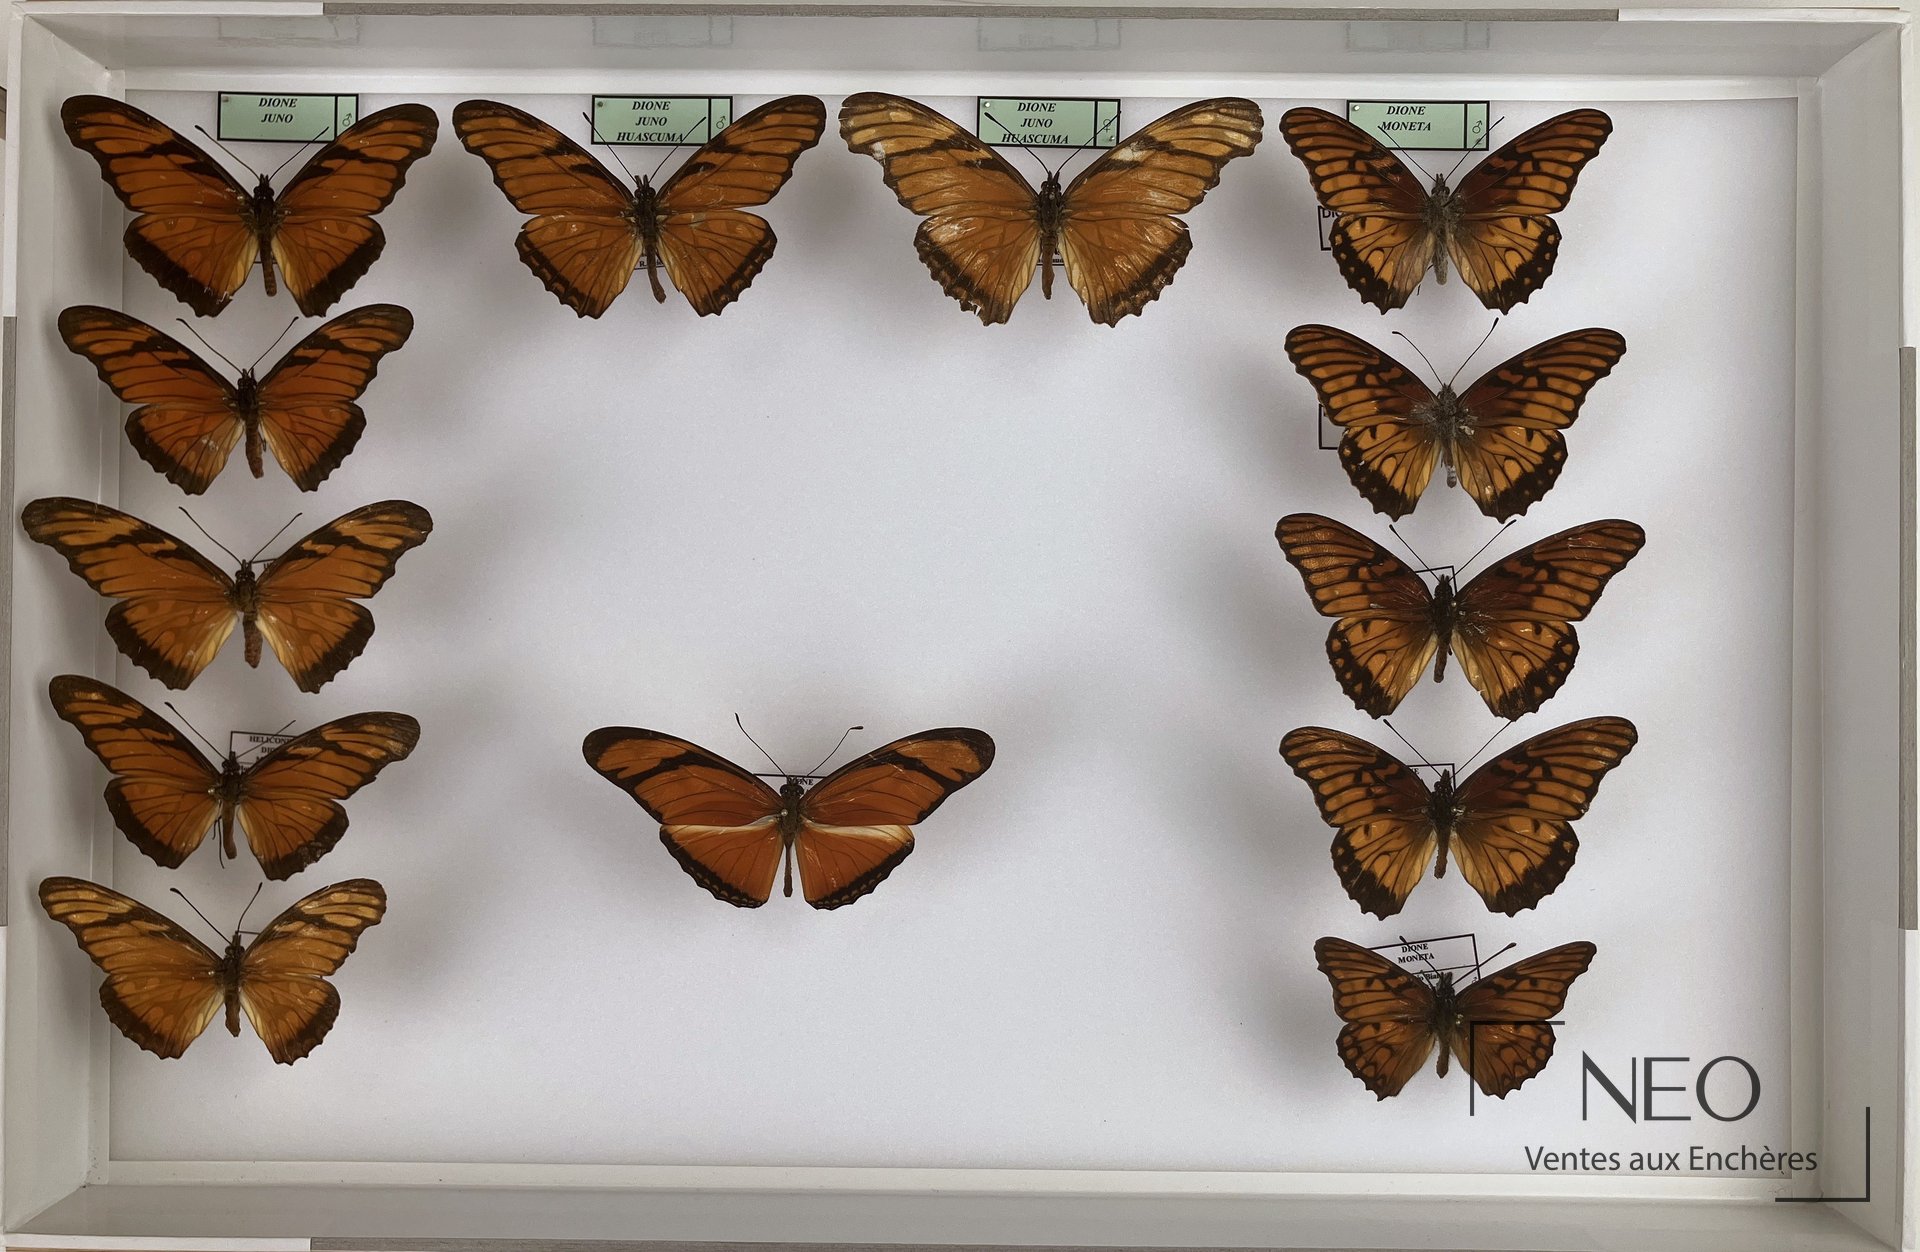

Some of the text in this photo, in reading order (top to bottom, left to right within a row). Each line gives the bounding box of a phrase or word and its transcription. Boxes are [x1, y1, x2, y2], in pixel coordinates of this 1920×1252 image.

[258, 97, 298, 108] DIONE
[631, 101, 671, 111] DIONE
[1017, 102, 1056, 112] DIONE
[1386, 105, 1426, 115] DIONE
[261, 113, 293, 124] JUNO
[635, 116, 668, 127] JUNO
[1020, 118, 1053, 128] JUNO
[1381, 121, 1431, 131] MONETA
[616, 132, 684, 142] HUASCUMA
[1001, 133, 1069, 144] HUASCUMA
[1401, 943, 1429, 953] DIONE
[1397, 953, 1435, 964] MONETA
